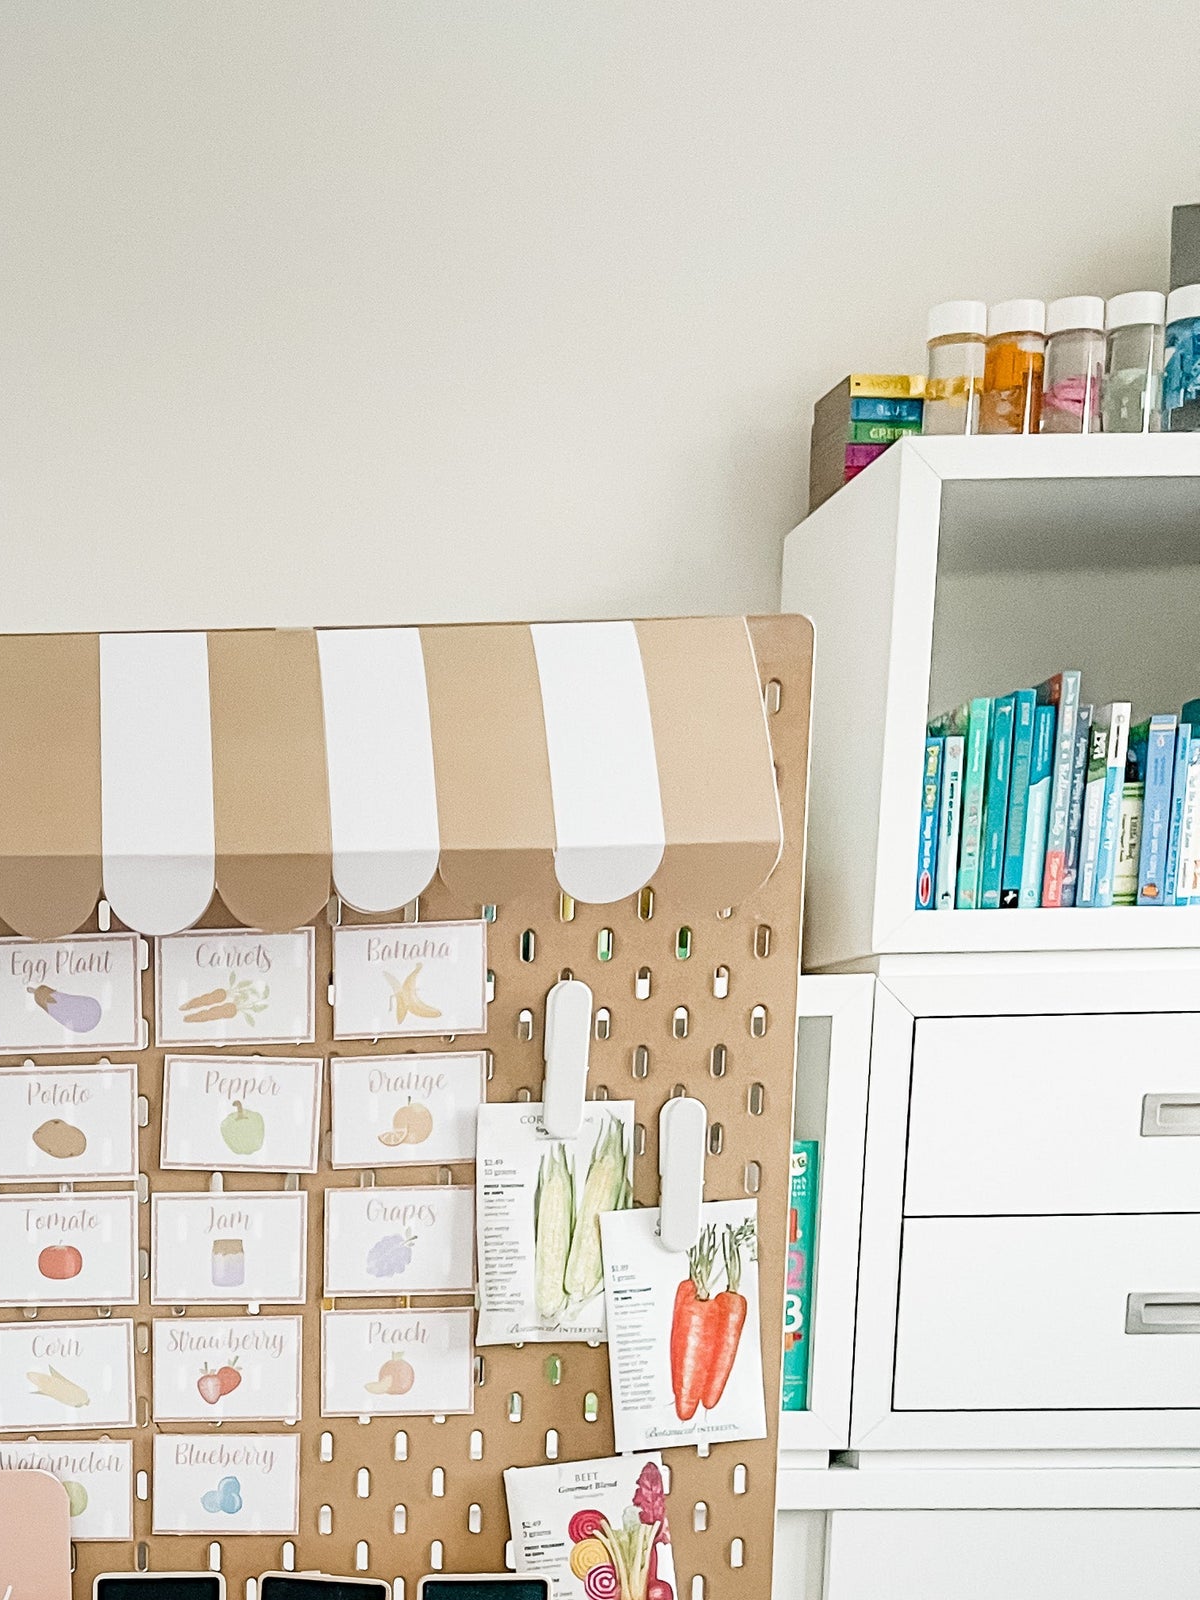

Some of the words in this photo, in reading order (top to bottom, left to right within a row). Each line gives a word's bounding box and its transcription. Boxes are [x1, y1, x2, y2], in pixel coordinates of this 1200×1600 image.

[196, 943, 273, 971] Carrots
[367, 937, 451, 962] Banana
[11, 951, 49, 983] Egg
[55, 949, 114, 976] Plant
[26, 1081, 92, 1106] Potato
[204, 1070, 281, 1100] Pepper
[368, 1069, 448, 1099] Orange
[22, 1208, 100, 1232] Tomato
[204, 1206, 251, 1233] Jam
[366, 1199, 438, 1227] Grapes
[31, 1335, 84, 1358] Corn
[167, 1329, 287, 1359] Strawberry
[368, 1321, 430, 1346] Peach
[0, 1451, 123, 1473] Watermelon
[175, 1443, 277, 1473] Blueberry
